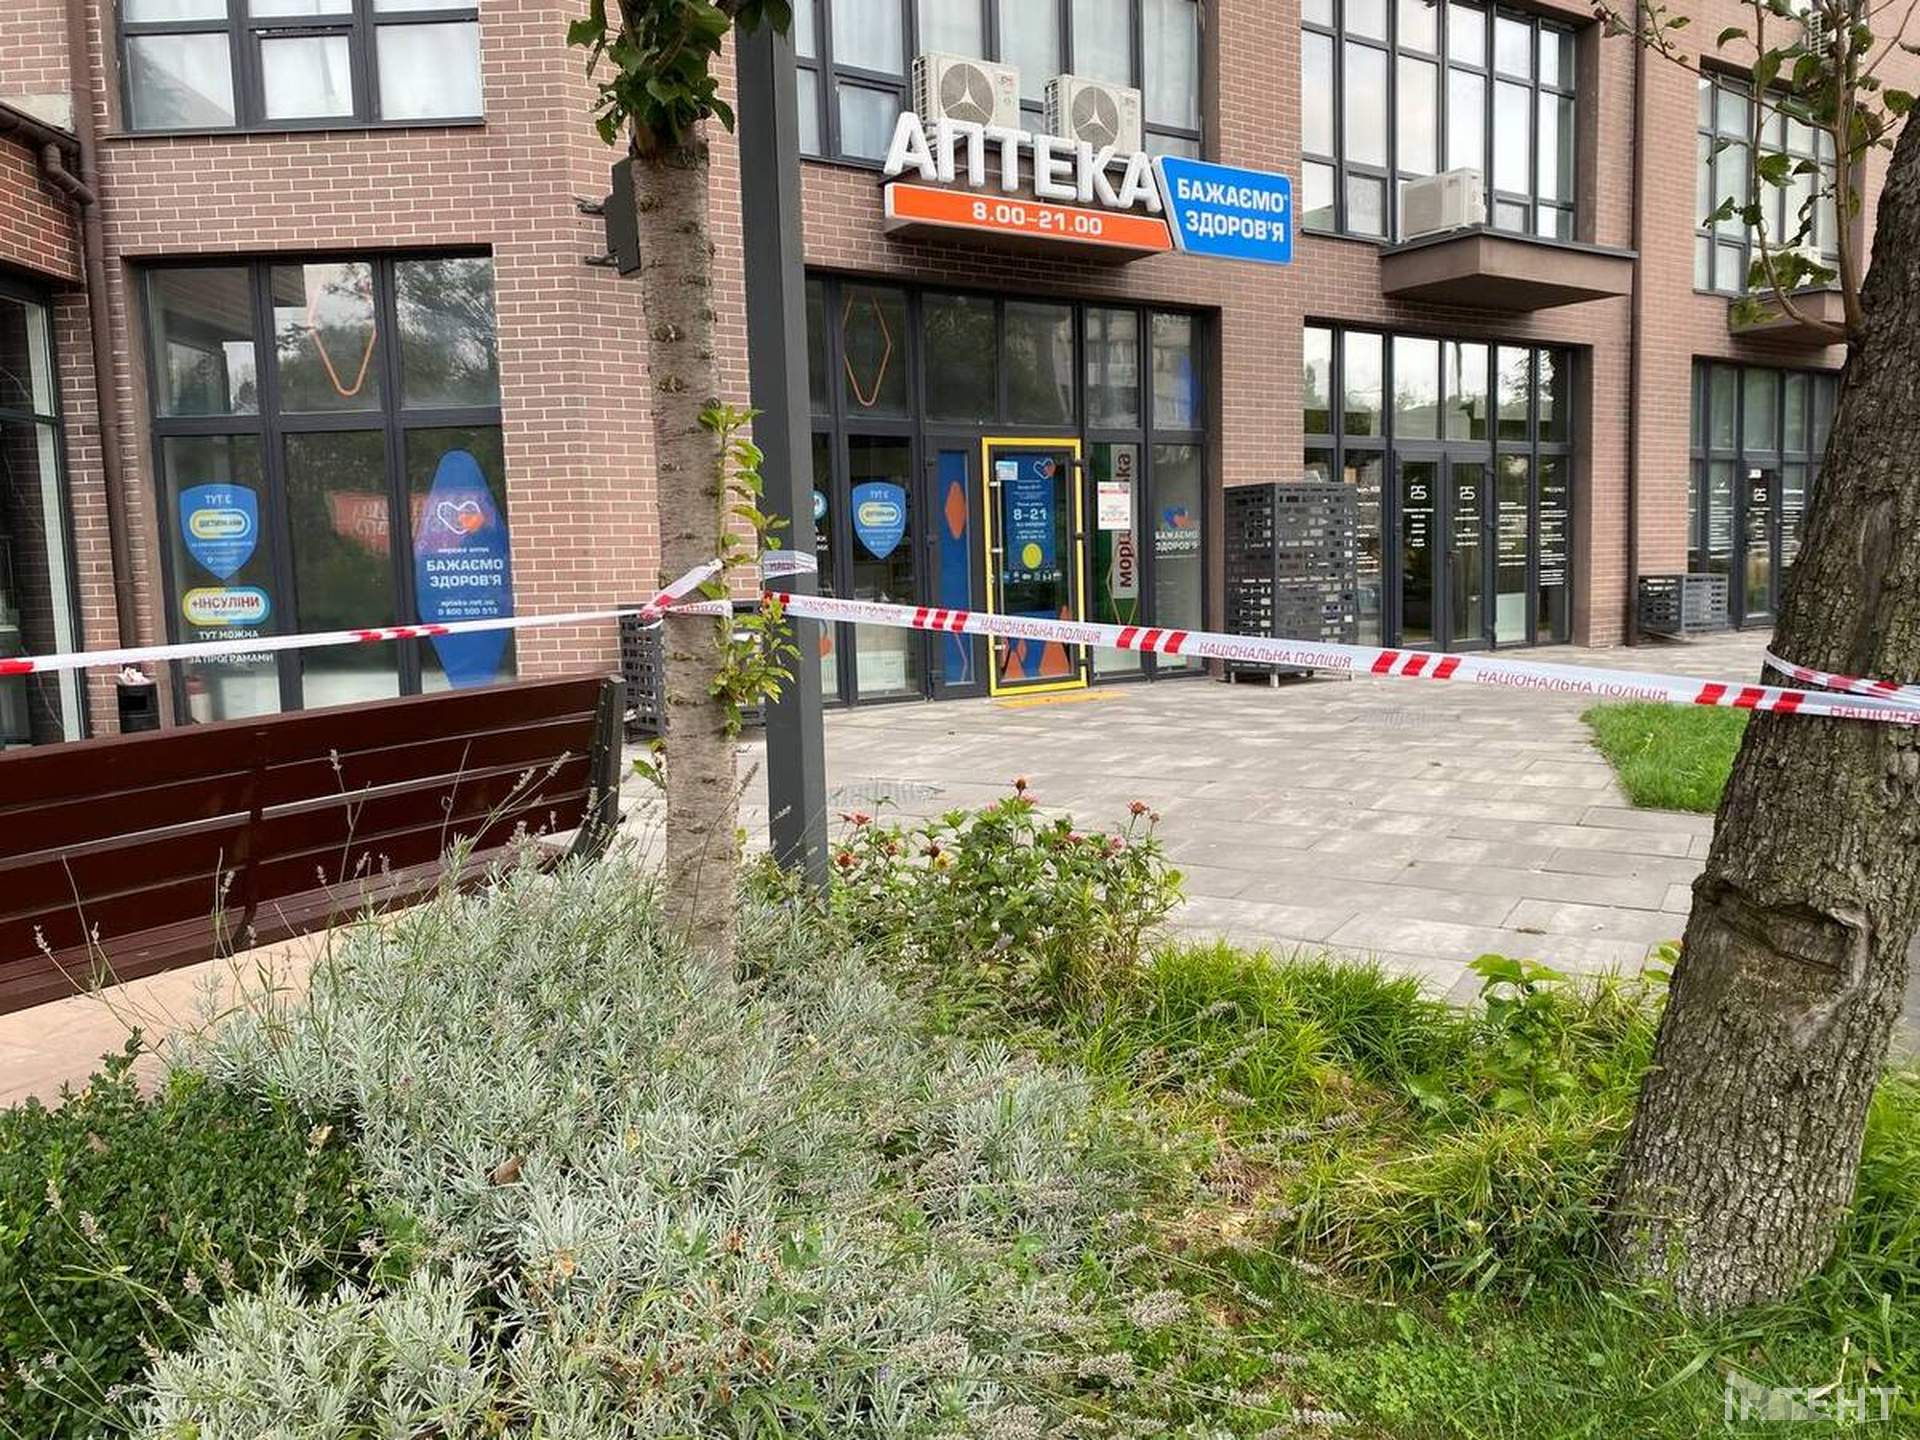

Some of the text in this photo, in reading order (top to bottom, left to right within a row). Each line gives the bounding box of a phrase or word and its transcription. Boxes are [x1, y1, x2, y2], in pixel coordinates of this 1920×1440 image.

[883, 111, 1164, 213] АПТЕКА
[1177, 177, 1284, 213] БАЖАЄМО
[1185, 209, 1284, 243] ЗДОРОВ'Я
[1013, 508, 1047, 521] 8-21
[1200, 642, 1353, 669] НАЦІОНАЛЬНА ПОЛІЦІЯ
[1476, 670, 1593, 694] НАЦІОНАЛЬНА
